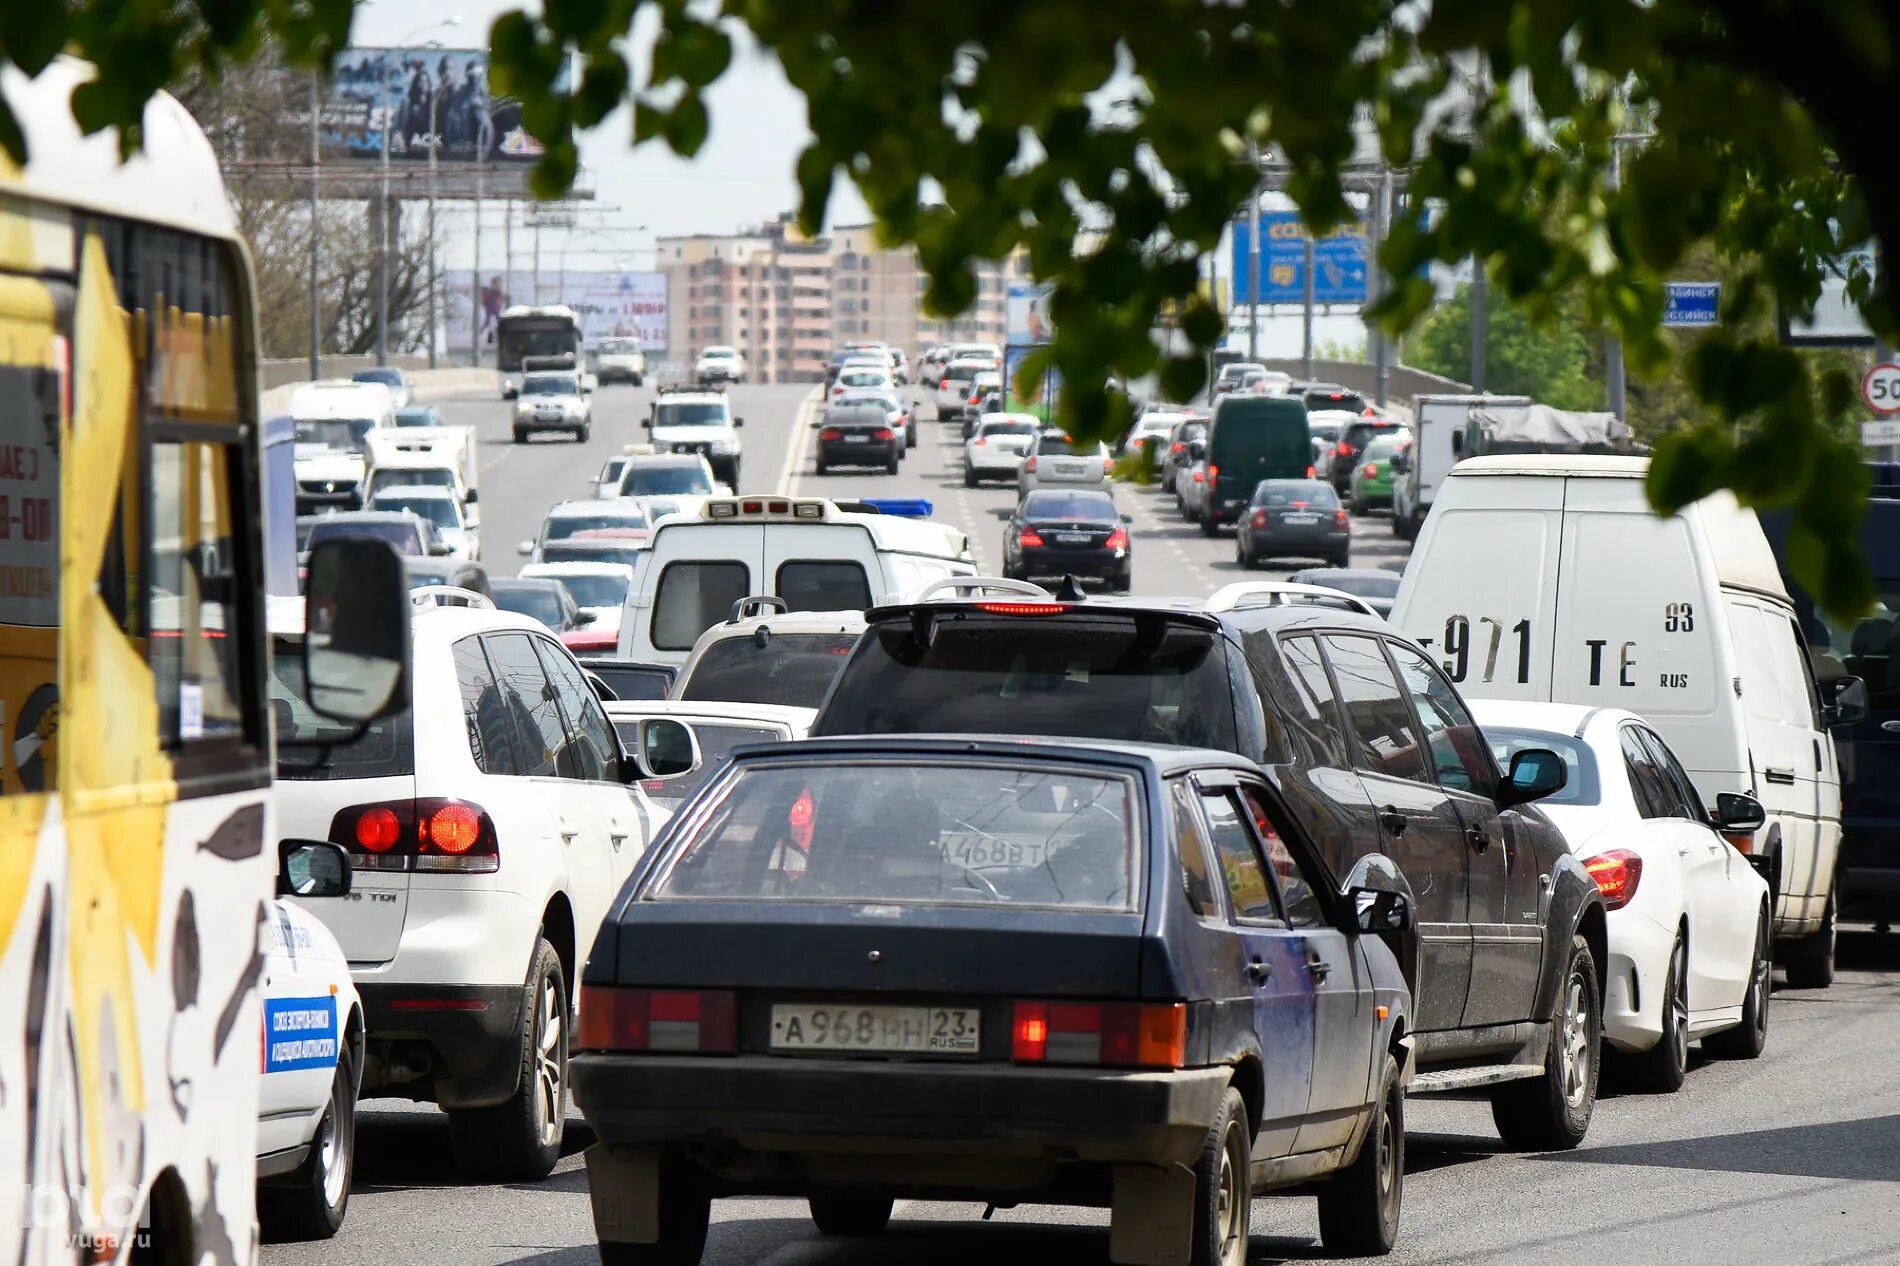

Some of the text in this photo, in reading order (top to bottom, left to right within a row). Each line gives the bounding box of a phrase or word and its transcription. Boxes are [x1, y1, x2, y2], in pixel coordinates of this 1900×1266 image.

[1872, 378, 1900, 400] 50
[1665, 602, 1694, 632] 93
[1660, 674, 1688, 689] RUS
[370, 891, 397, 903] TDI
[934, 1011, 966, 1036] 23
[929, 1037, 956, 1048] RUS
